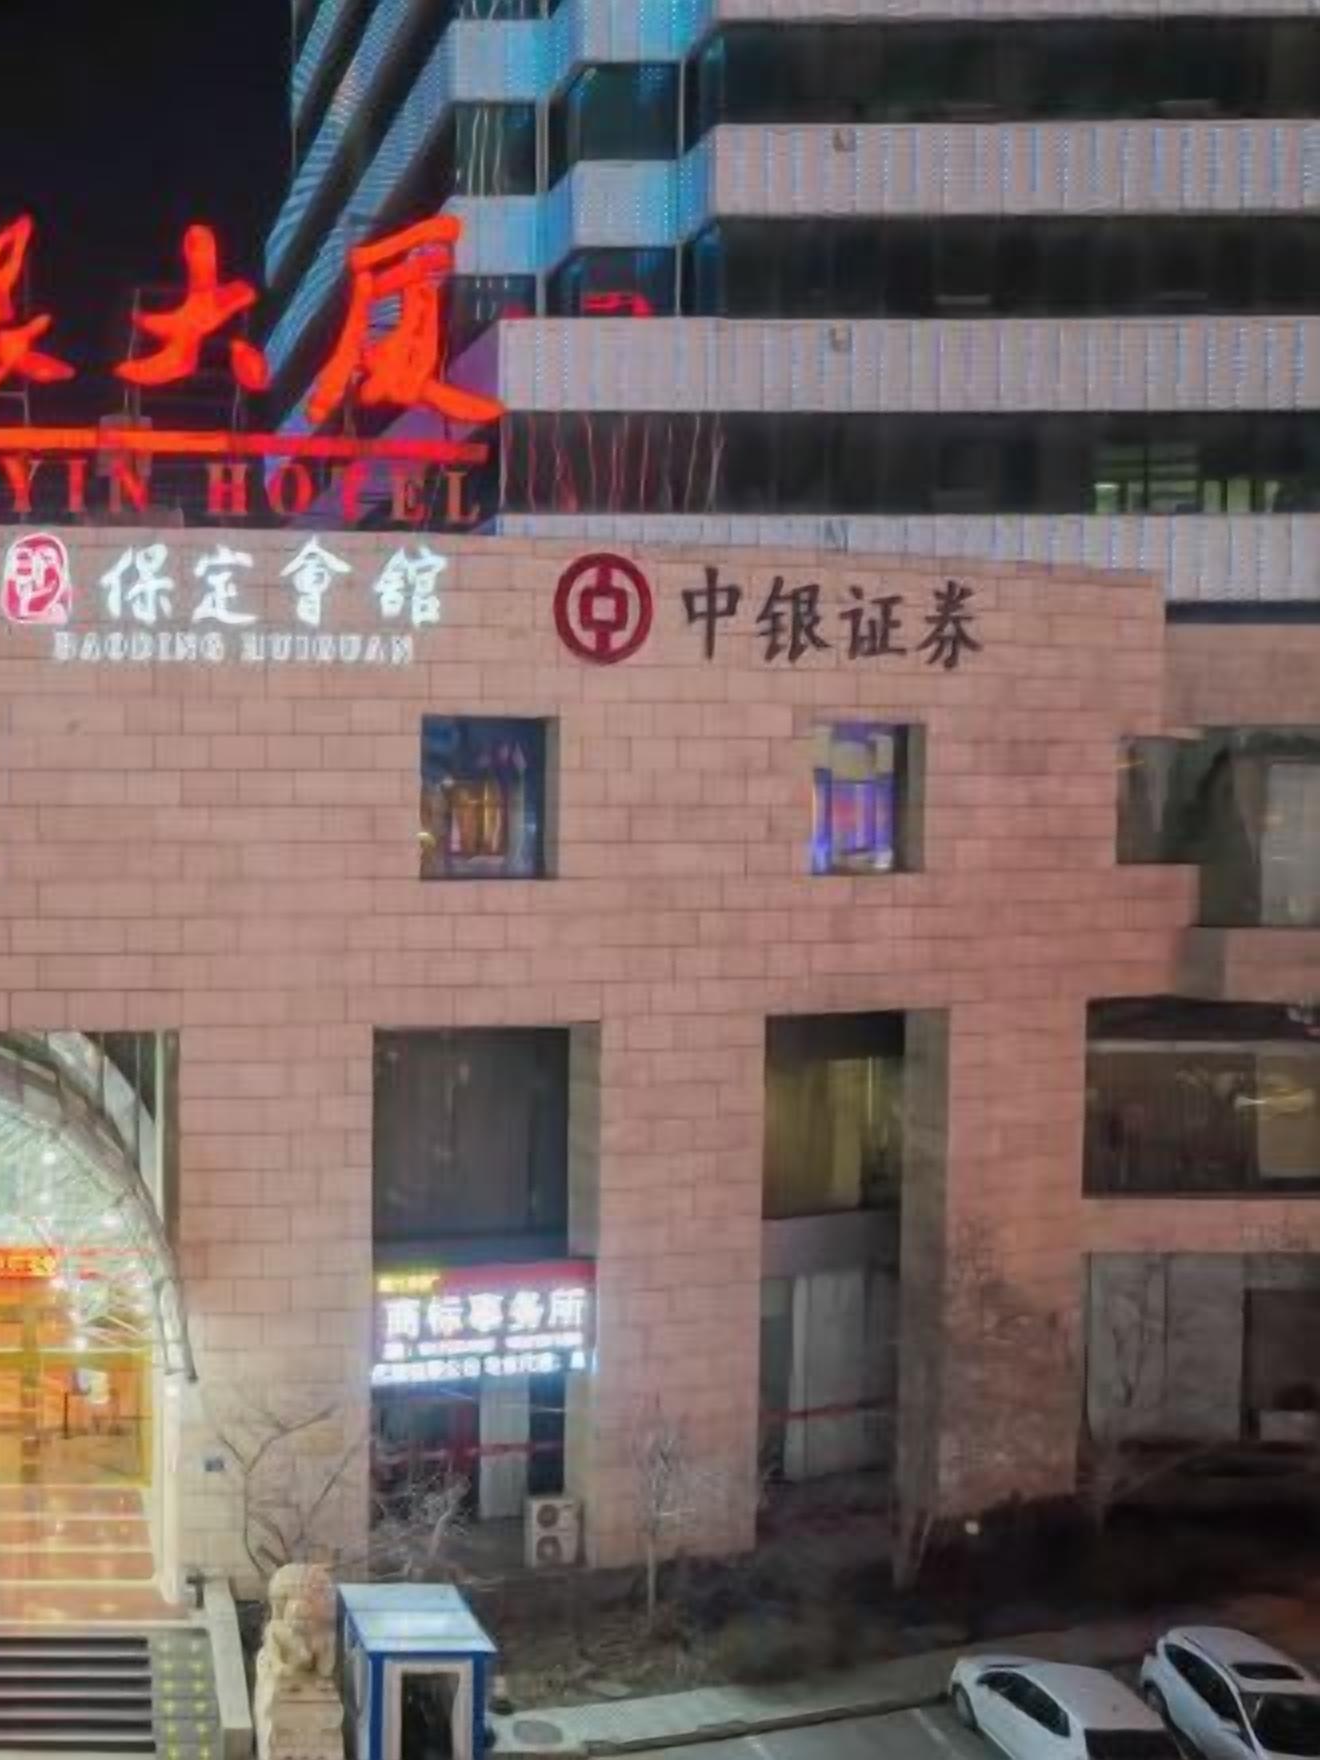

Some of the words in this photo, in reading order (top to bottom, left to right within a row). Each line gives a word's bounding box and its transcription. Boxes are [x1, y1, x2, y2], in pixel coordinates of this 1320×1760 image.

[206, 462, 482, 524] HOTEL
[52, 630, 226, 661] BAODING
[681, 565, 984, 670] 中银证券
